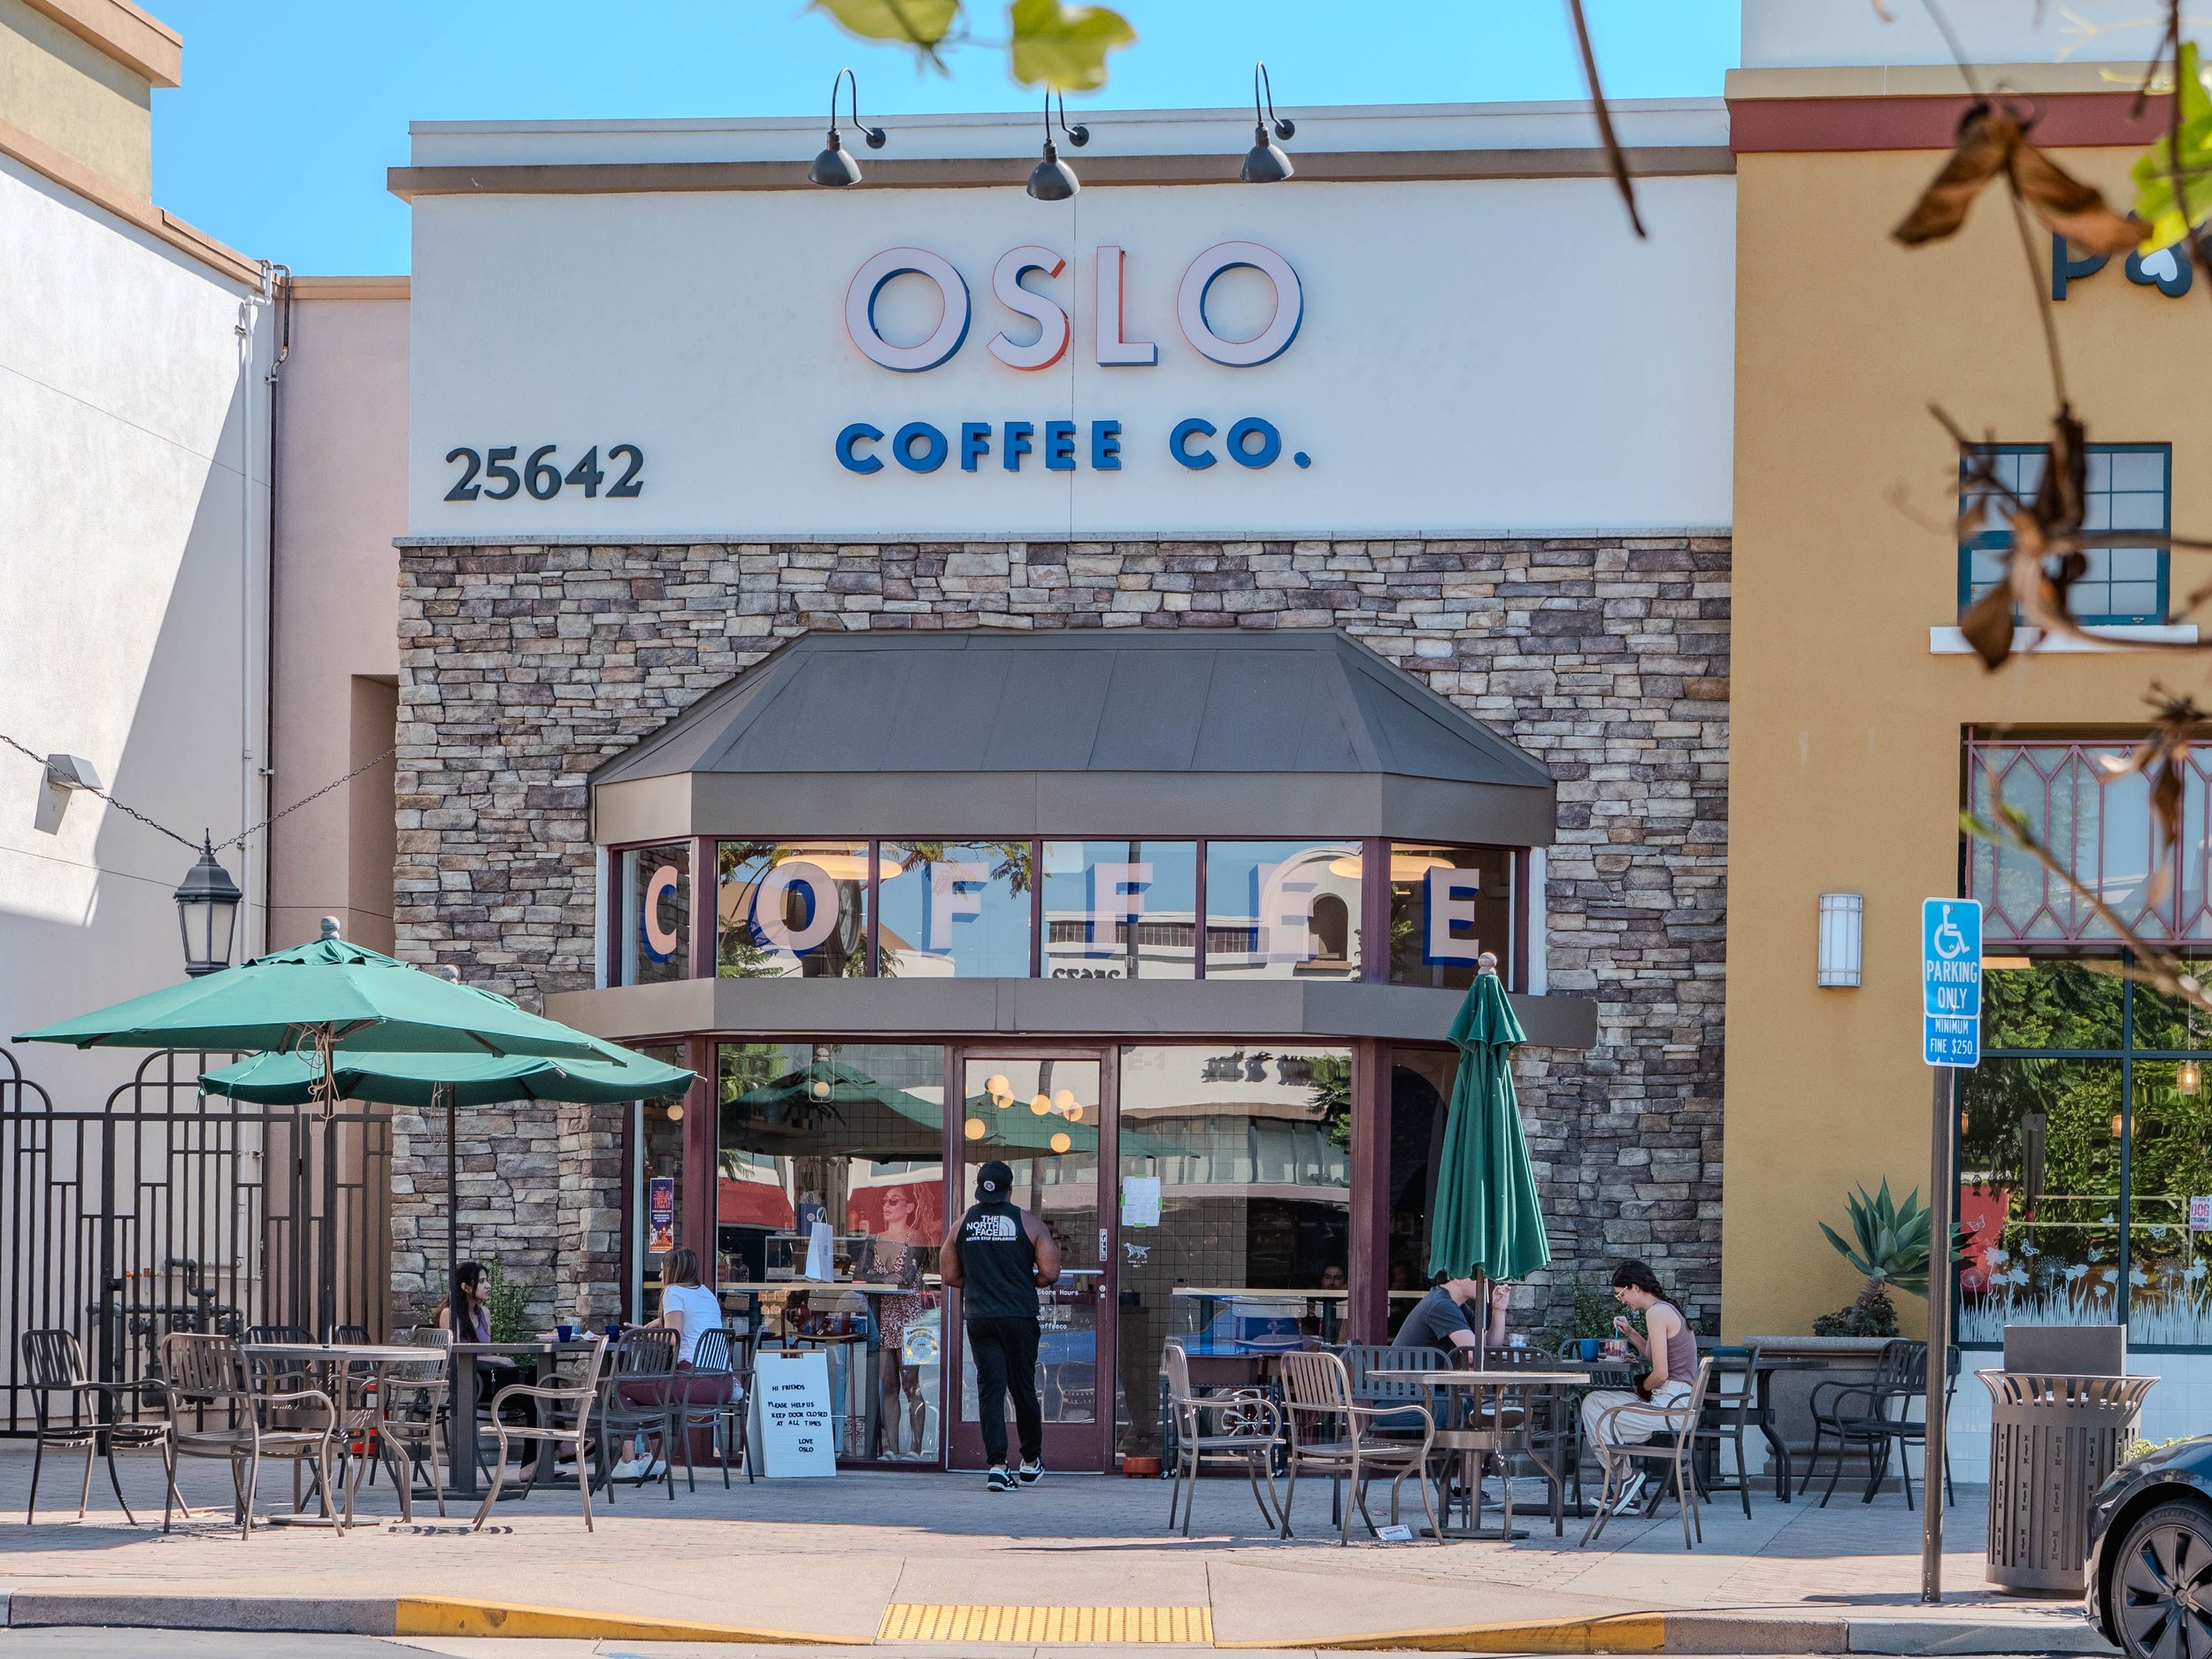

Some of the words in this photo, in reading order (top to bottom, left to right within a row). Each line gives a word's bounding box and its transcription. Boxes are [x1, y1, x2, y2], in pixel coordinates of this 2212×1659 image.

[844, 241, 1304, 373] OSLO
[835, 419, 1122, 475] COFFEE
[1168, 416, 1311, 472] CO.
[442, 442, 644, 502] 25642
[641, 860, 1479, 968] COFFEE
[1925, 960, 1978, 983] PARKING
[1937, 987, 1968, 1010] ONLY
[1935, 1018, 1969, 1034] MINIMUM
[1930, 1038, 1947, 1053] FINE
[1951, 1038, 1973, 1055] $250
[2191, 1203, 2209, 1217] DOG
[966, 1221, 999, 1231] NORTH
[975, 1228, 999, 1237] FACE
